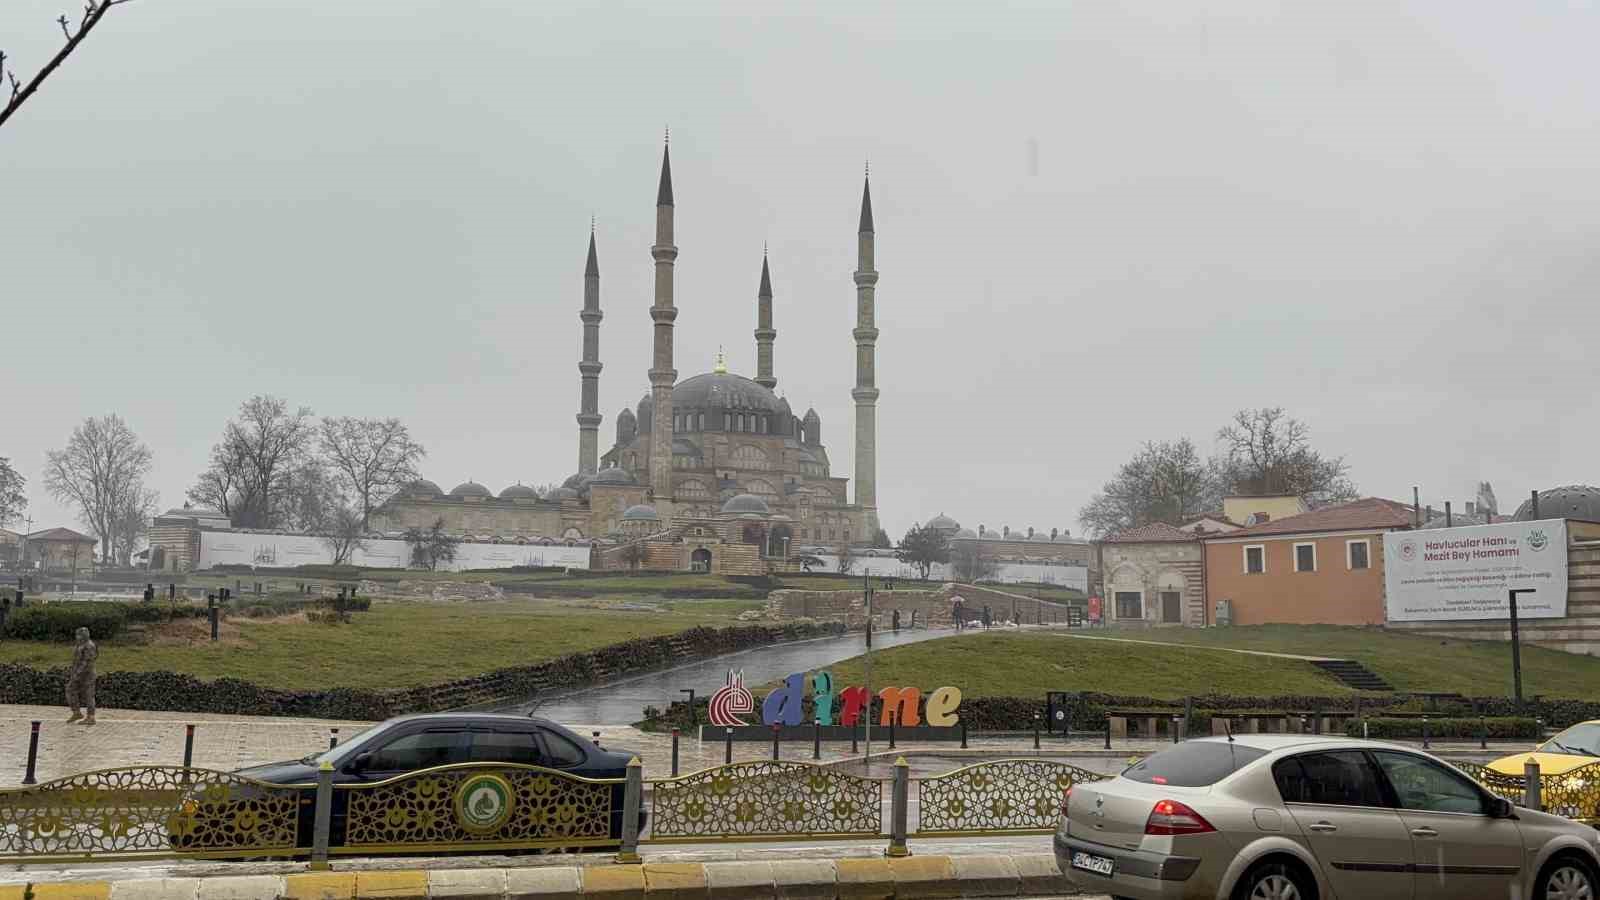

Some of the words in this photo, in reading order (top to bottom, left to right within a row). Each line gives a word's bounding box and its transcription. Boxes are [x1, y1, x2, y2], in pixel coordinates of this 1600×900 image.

[1425, 539, 1480, 551] Havlucular
[1482, 536, 1507, 546] Hanı
[1424, 551, 1450, 562] Mezit
[1452, 551, 1471, 562] Bey
[1472, 548, 1520, 559] Hamamı
